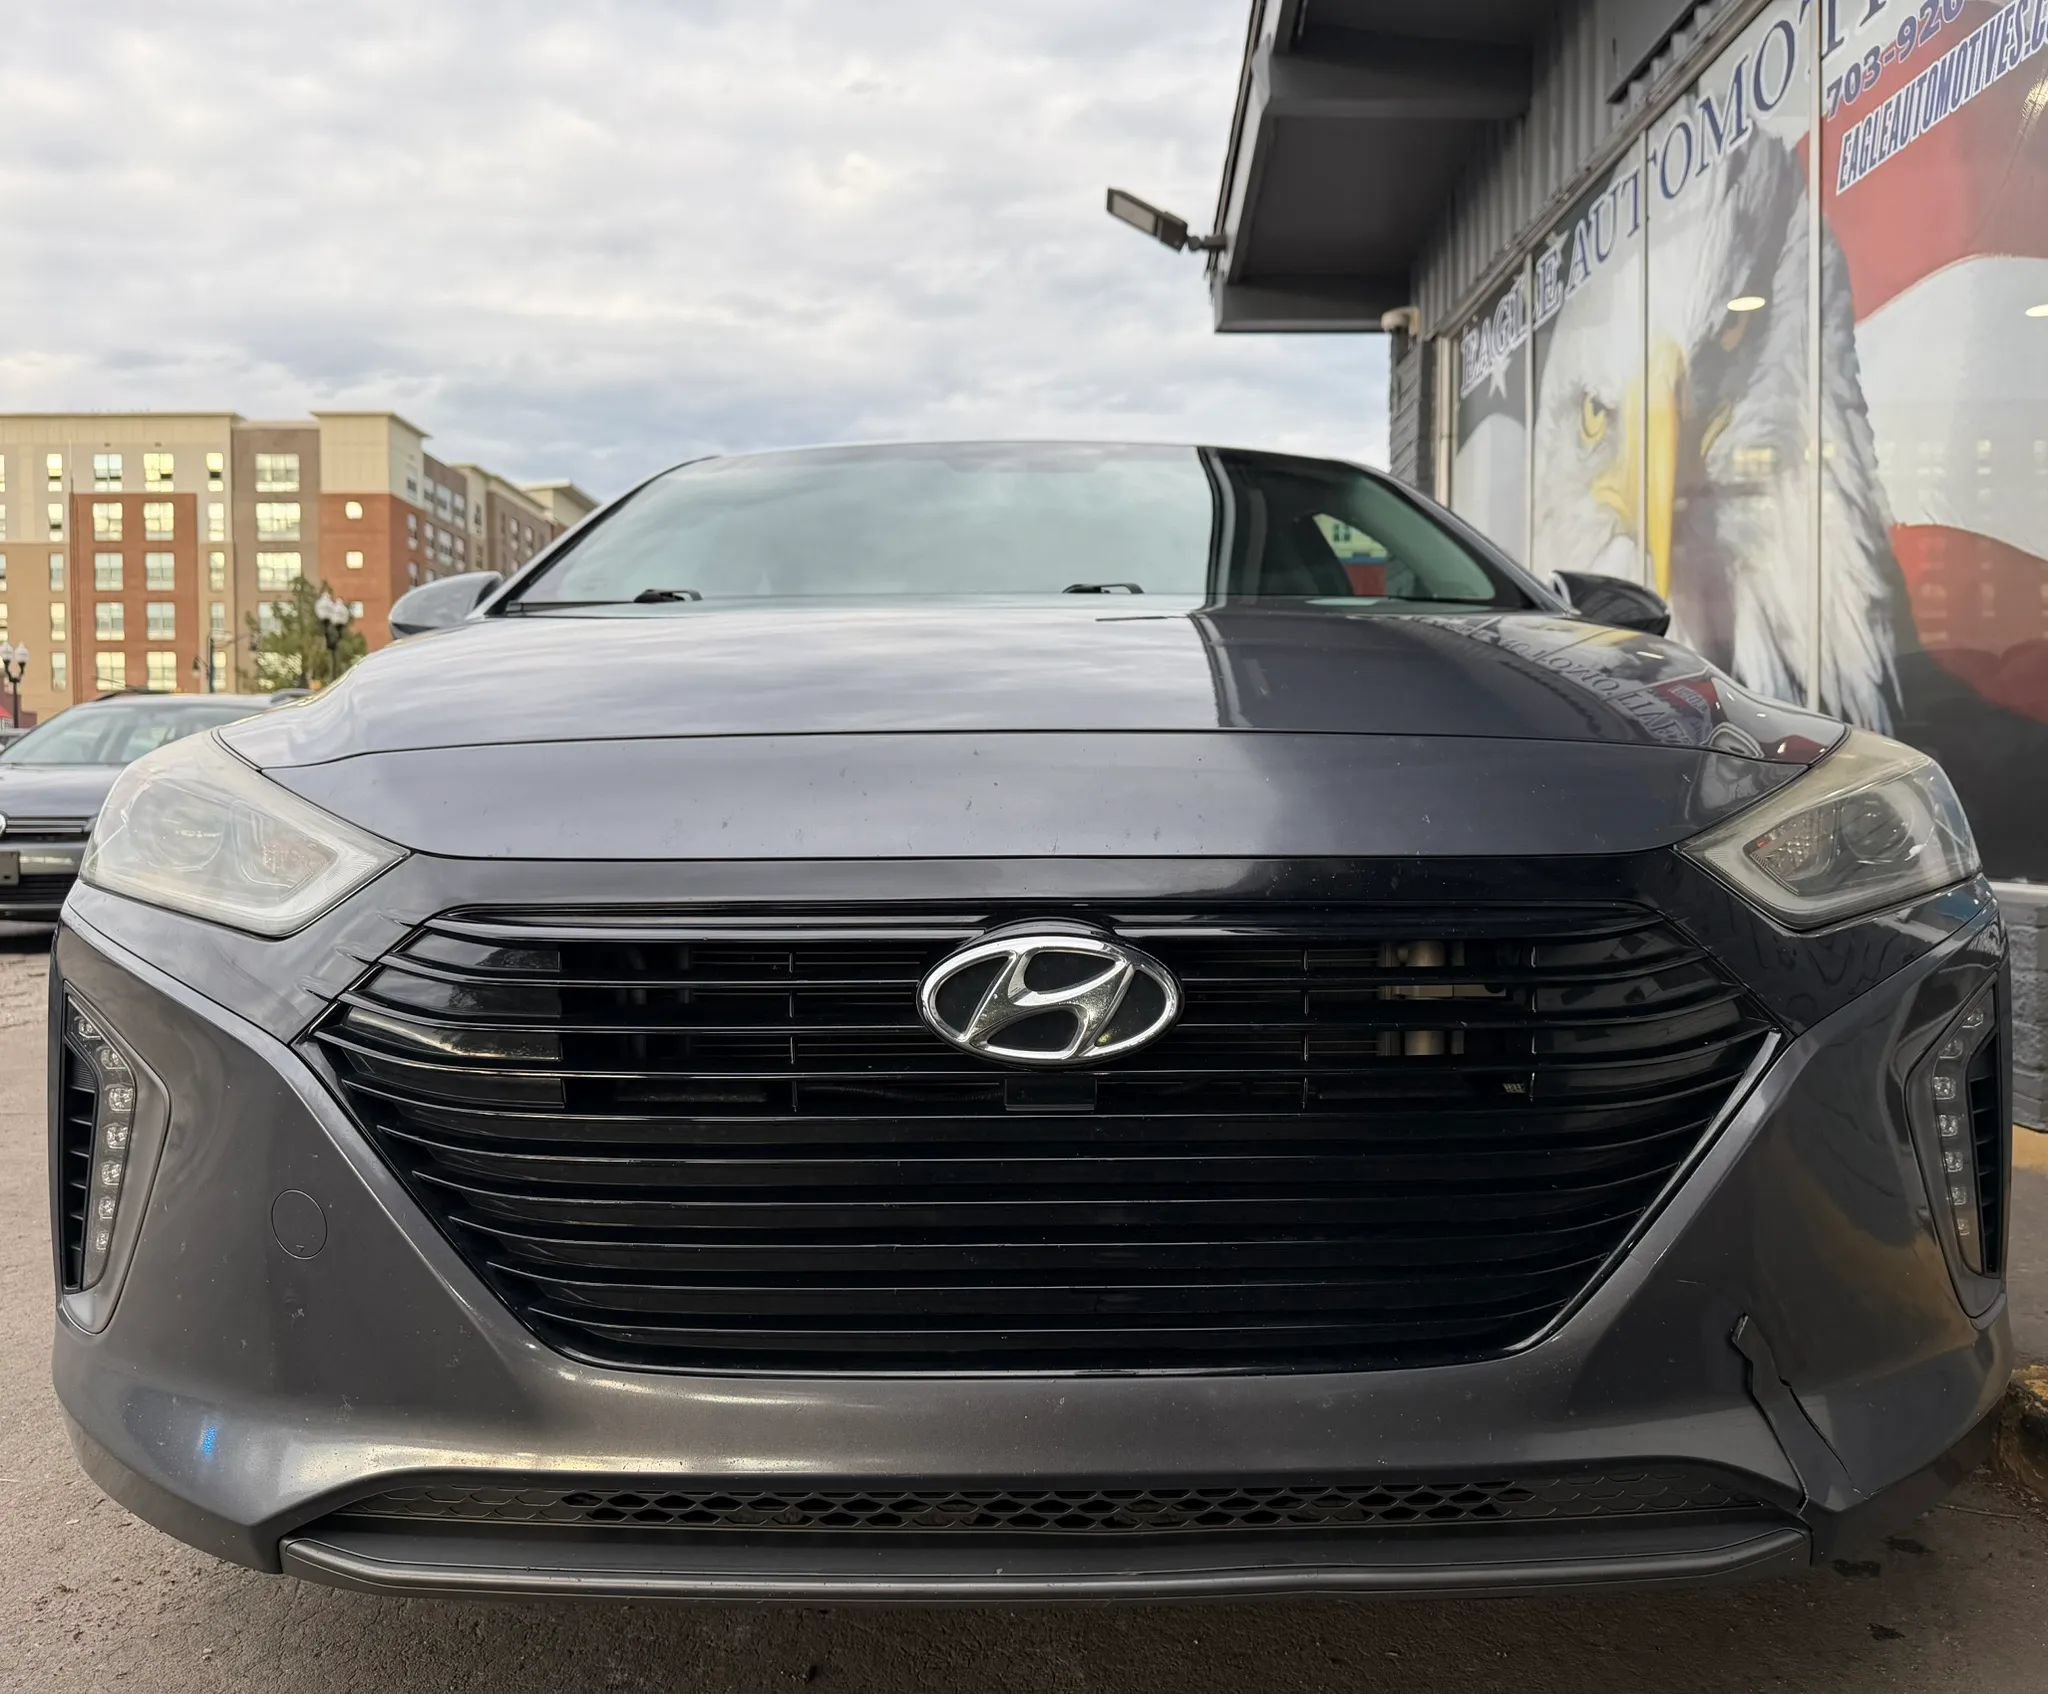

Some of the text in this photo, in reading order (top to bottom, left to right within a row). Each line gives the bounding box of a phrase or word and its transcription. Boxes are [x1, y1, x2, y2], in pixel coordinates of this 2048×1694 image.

[1461, 0, 1887, 398] EAGLE AUTOMOT
[1836, 0, 2048, 195] EAGLEAUTOMOTIVES.C
